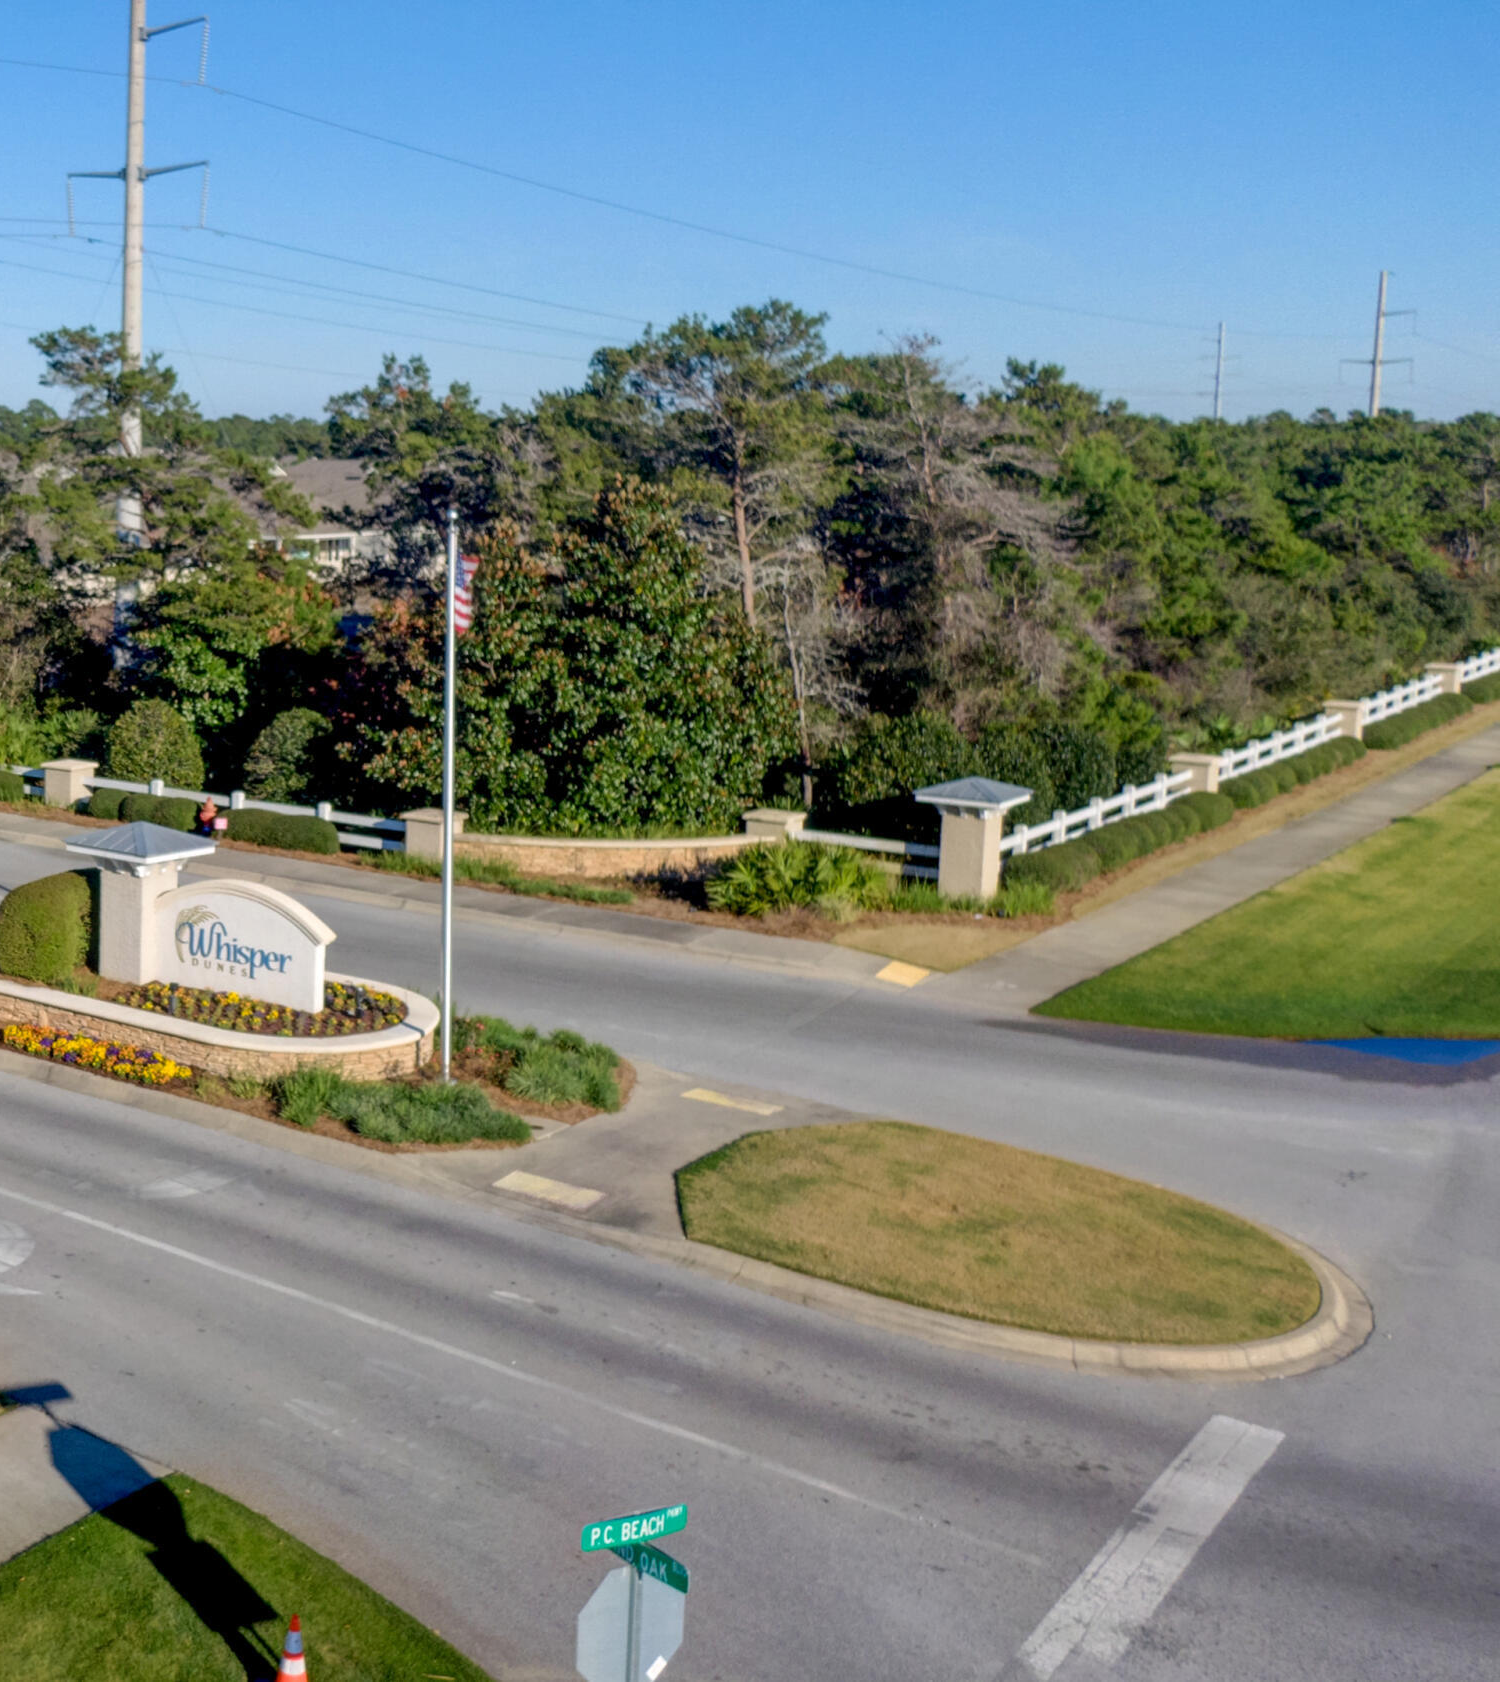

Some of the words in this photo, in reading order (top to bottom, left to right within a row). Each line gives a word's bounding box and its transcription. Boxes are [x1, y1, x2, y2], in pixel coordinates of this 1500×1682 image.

[175, 921, 292, 979] Whisper
[191, 957, 248, 977] DUNES
[621, 1514, 665, 1541] BEACH
[640, 1552, 668, 1582] OAK
